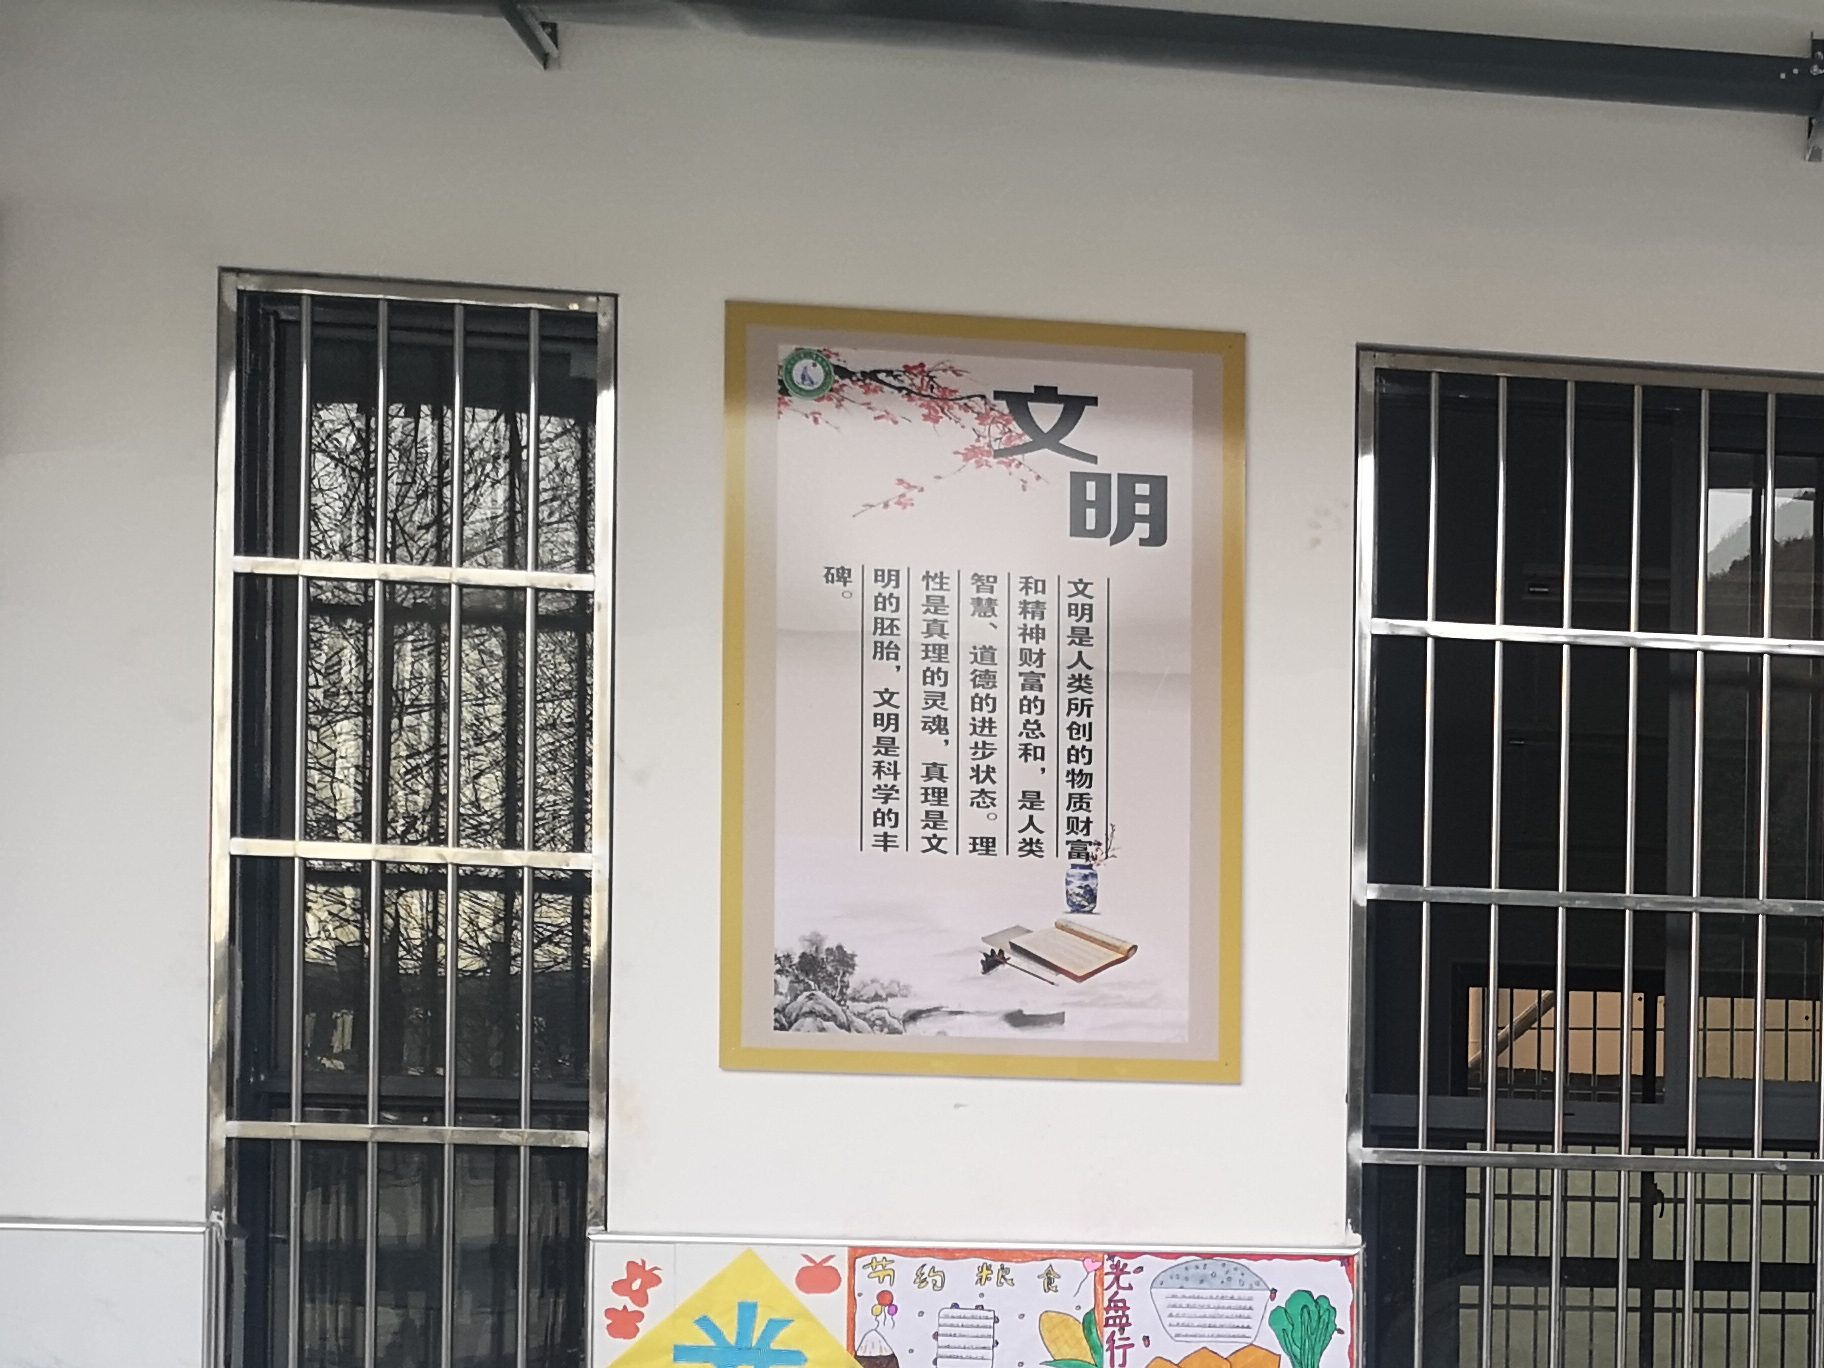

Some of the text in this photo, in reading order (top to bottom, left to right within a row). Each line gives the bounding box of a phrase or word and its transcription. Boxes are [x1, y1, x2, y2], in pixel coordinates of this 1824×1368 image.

[993, 385, 1168, 547] 文明
[921, 569, 951, 855] 性是真理的灵魂，真理是文
[1017, 575, 1047, 859] 和精神财富的总和，是人类
[1065, 577, 1094, 862] 文明是人类所创的物质财富
